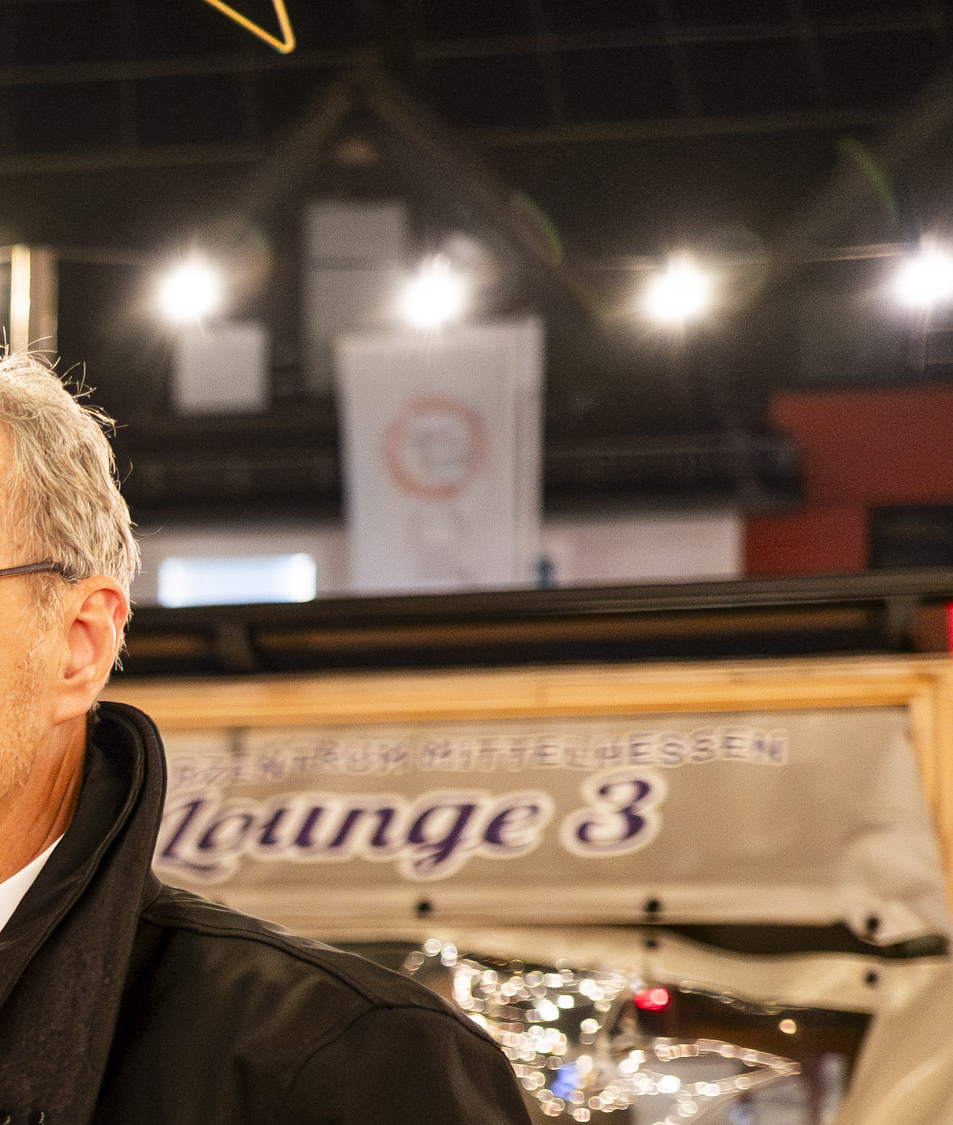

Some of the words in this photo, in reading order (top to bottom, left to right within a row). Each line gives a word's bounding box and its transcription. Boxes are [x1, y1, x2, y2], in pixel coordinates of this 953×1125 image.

[418, 727, 788, 772] MITTELHESSEN
[154, 795, 550, 880] Lounge
[566, 769, 664, 856] 3
